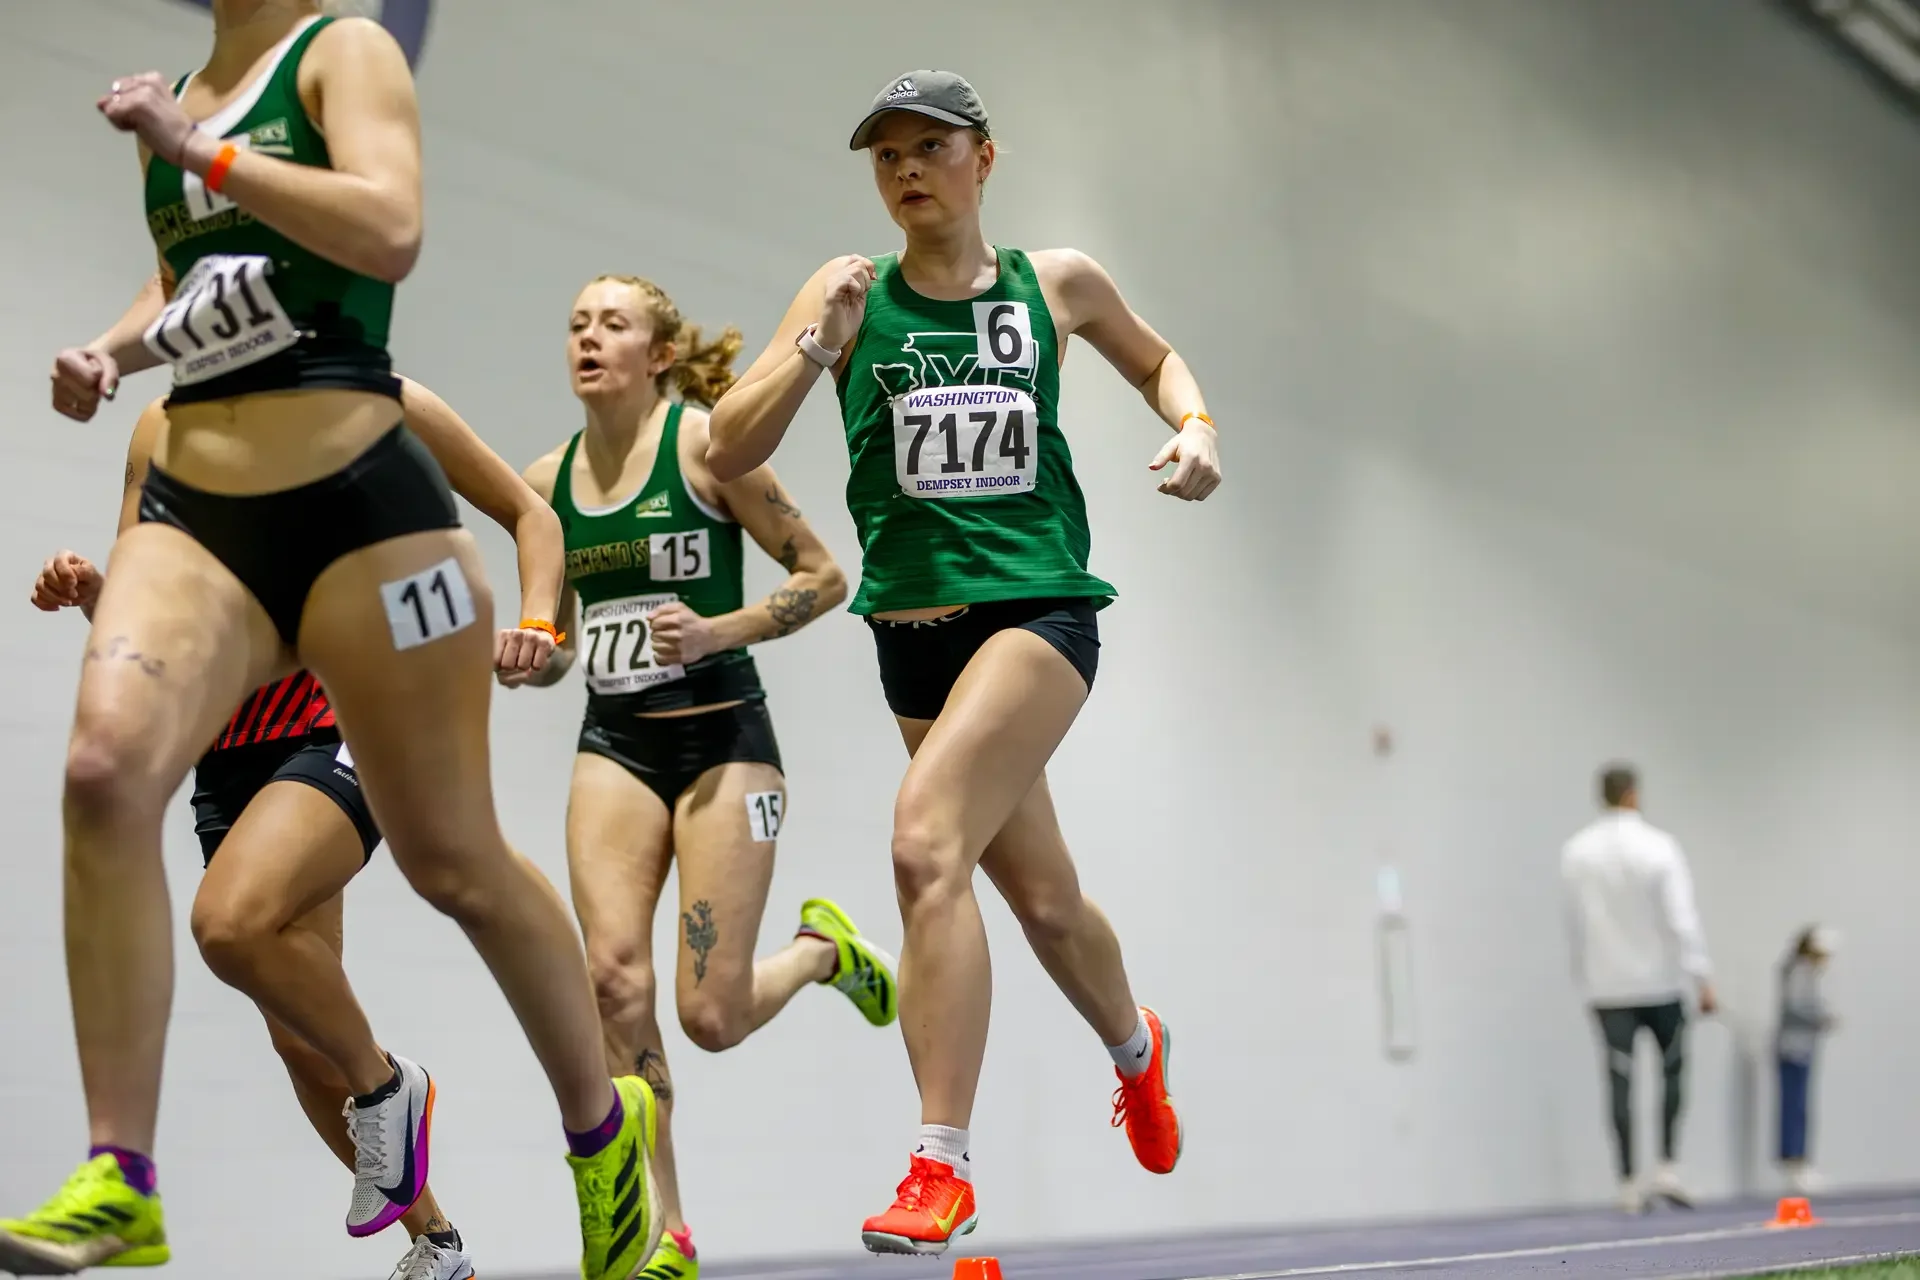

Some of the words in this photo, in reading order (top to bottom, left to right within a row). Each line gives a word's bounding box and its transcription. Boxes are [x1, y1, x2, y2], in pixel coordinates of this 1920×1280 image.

[886, 90, 919, 101] adidas
[987, 304, 1023, 364] 6
[908, 391, 1018, 408] WASHINGTON
[903, 409, 1030, 475] 7174
[916, 478, 972, 491] DEMPSEY
[975, 475, 1021, 488] INDOOR
[662, 533, 701, 577] 15
[400, 570, 458, 638] 11
[587, 619, 651, 676] 772
[755, 794, 780, 837] 15
